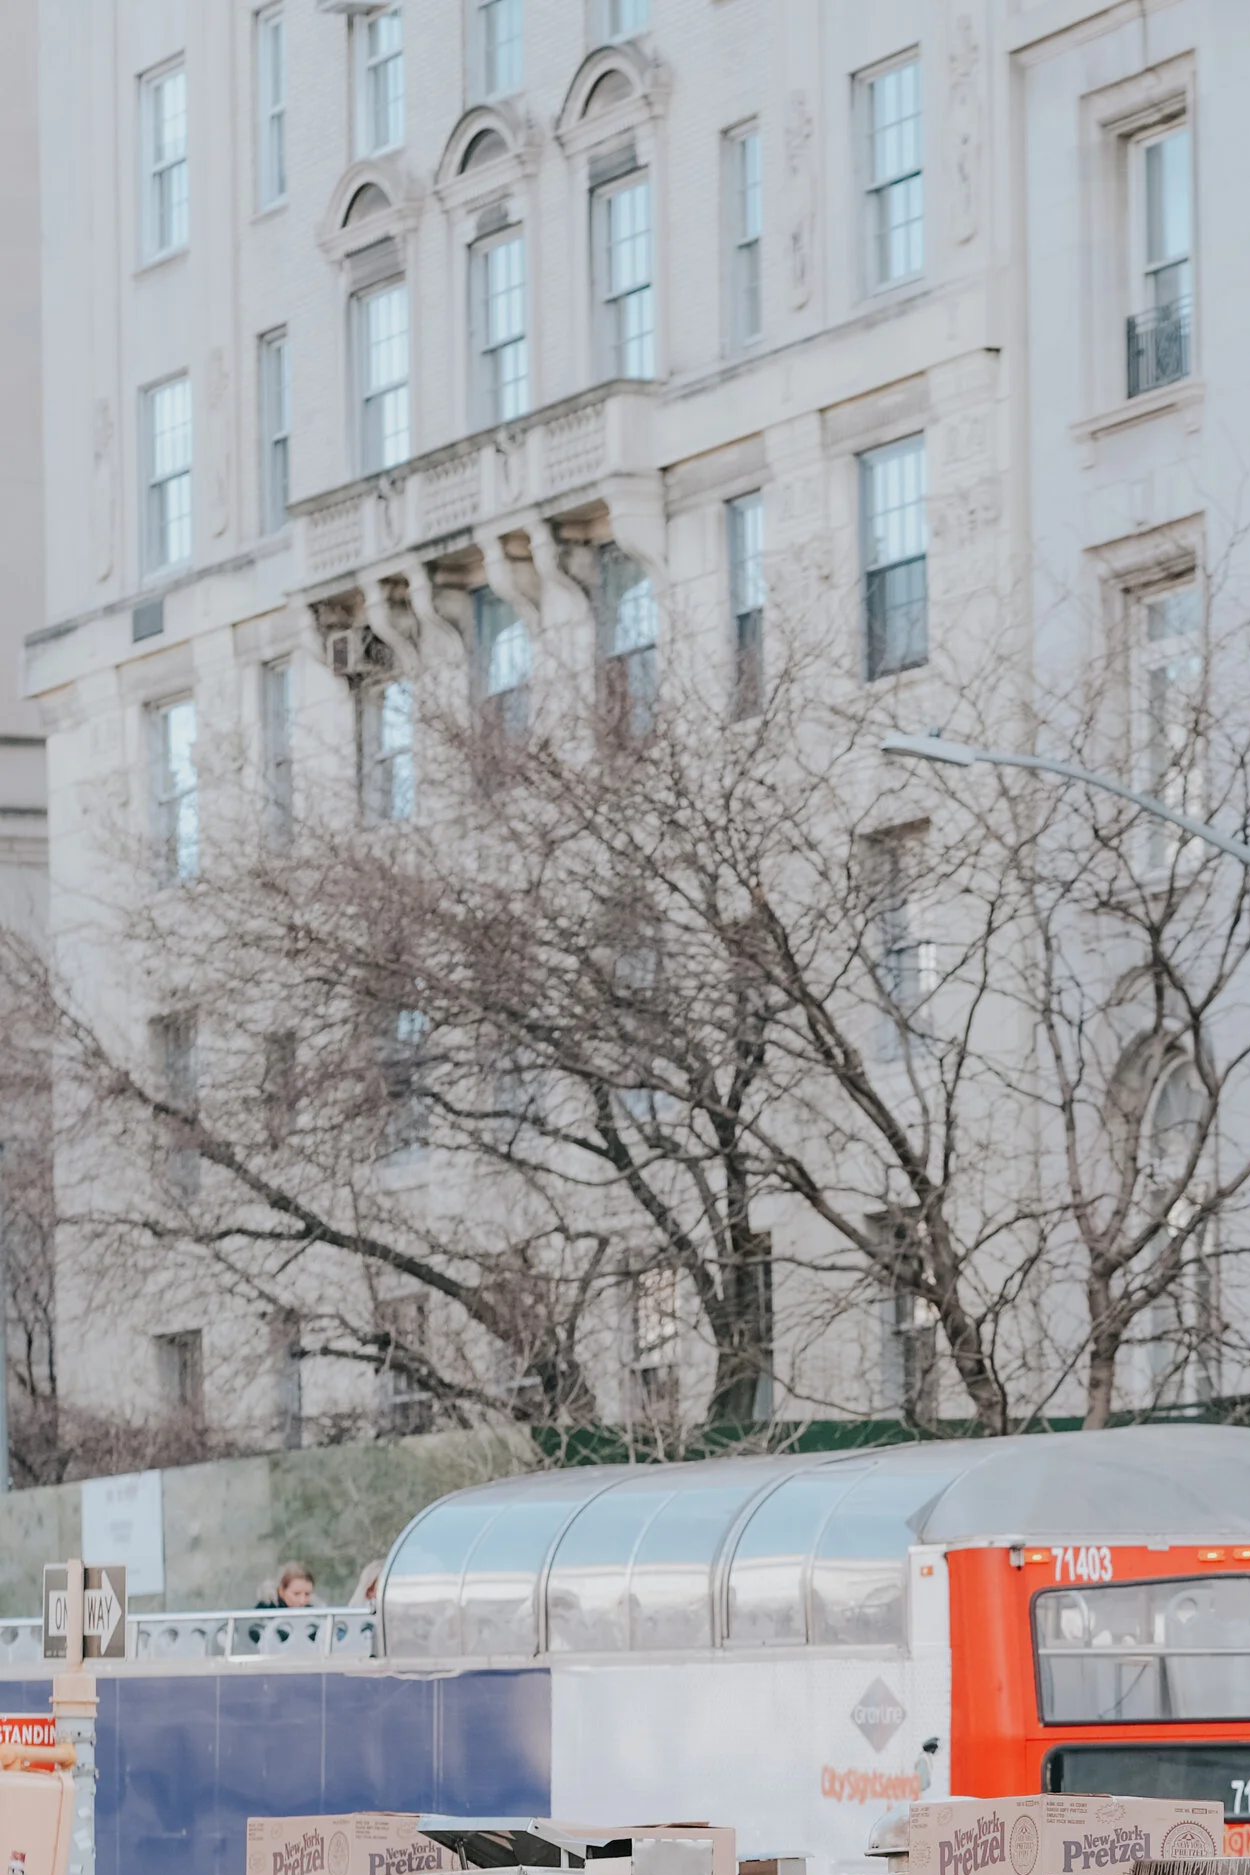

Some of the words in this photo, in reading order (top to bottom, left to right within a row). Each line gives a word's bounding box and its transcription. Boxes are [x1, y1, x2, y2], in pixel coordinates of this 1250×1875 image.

[1052, 1546, 1113, 1581] 71403
[87, 1596, 112, 1631] WAY
[0, 1725, 56, 1745] TANDIN
[285, 1839, 301, 1861] New
[302, 1828, 320, 1848] York
[954, 1828, 974, 1853] New
[976, 1810, 1000, 1840] York
[1083, 1834, 1111, 1850] New
[1113, 1825, 1144, 1844] York
[385, 1847, 409, 1860] New
[411, 1840, 436, 1855] York
[1062, 1832, 1151, 1873] Pretzel
